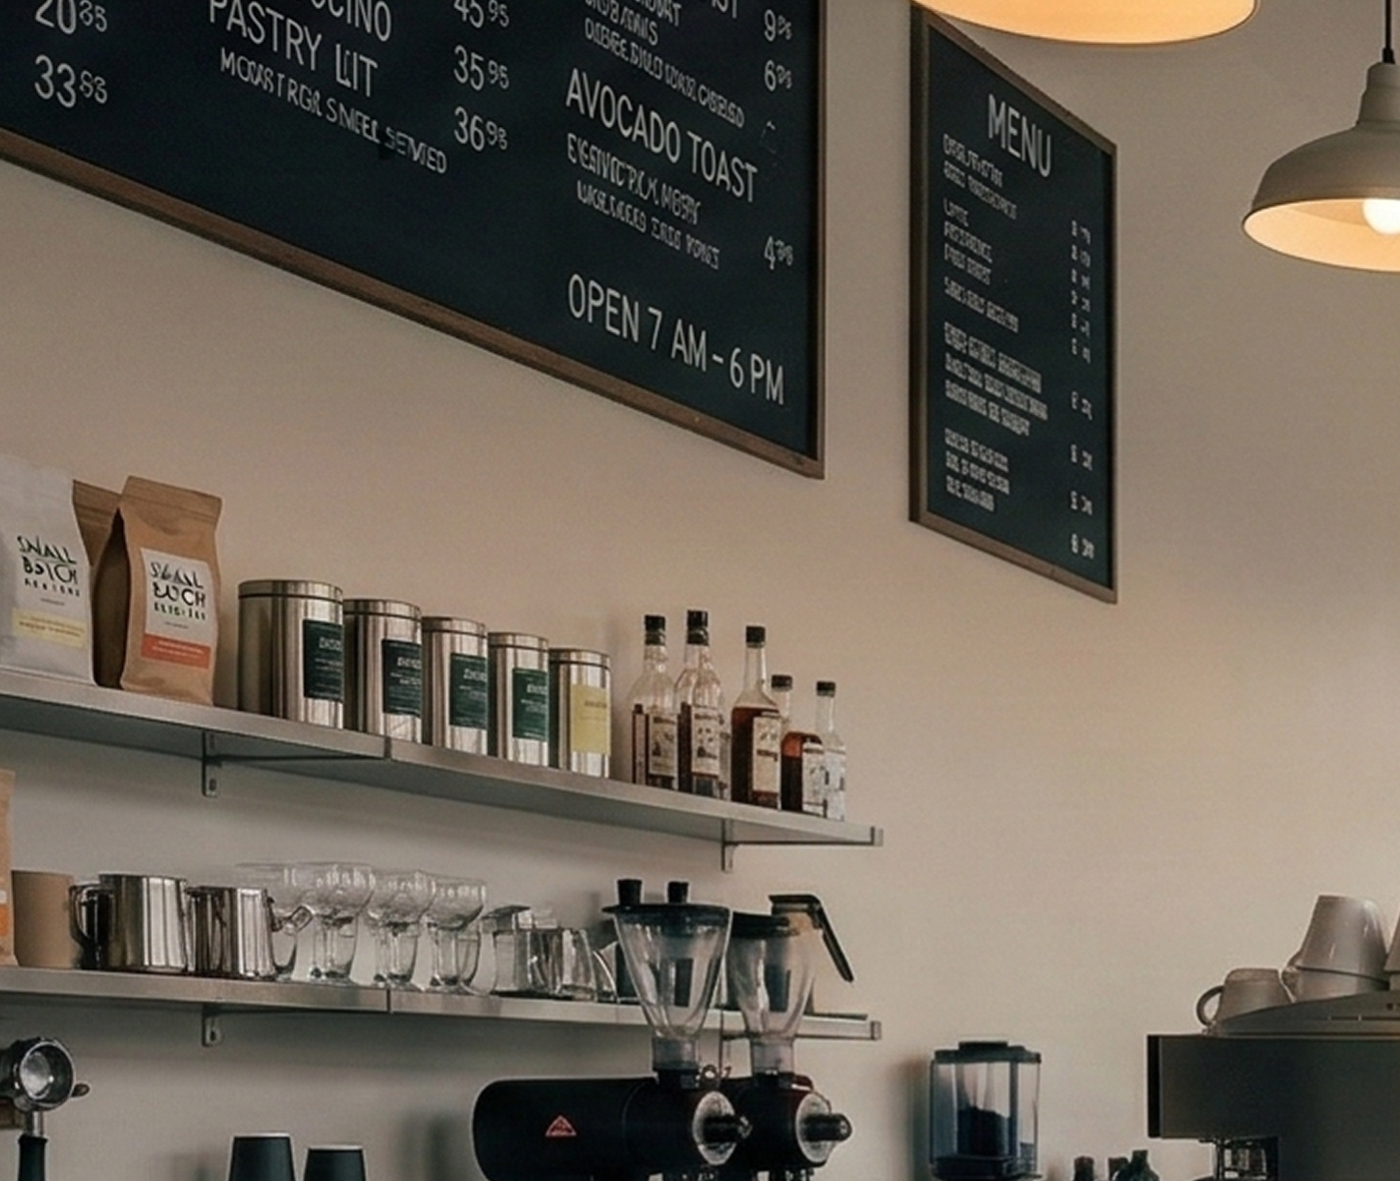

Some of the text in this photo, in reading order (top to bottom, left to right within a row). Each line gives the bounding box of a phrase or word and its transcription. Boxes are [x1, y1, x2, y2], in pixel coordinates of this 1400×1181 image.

[565, 67, 682, 164] AVOCADO
[687, 130, 759, 203] TOAST
[987, 92, 1052, 178] MENU
[568, 273, 640, 343] OPEN
[647, 306, 663, 351] 7
[670, 318, 707, 373] AM
[729, 347, 745, 389] 6
[750, 353, 785, 406] PM
